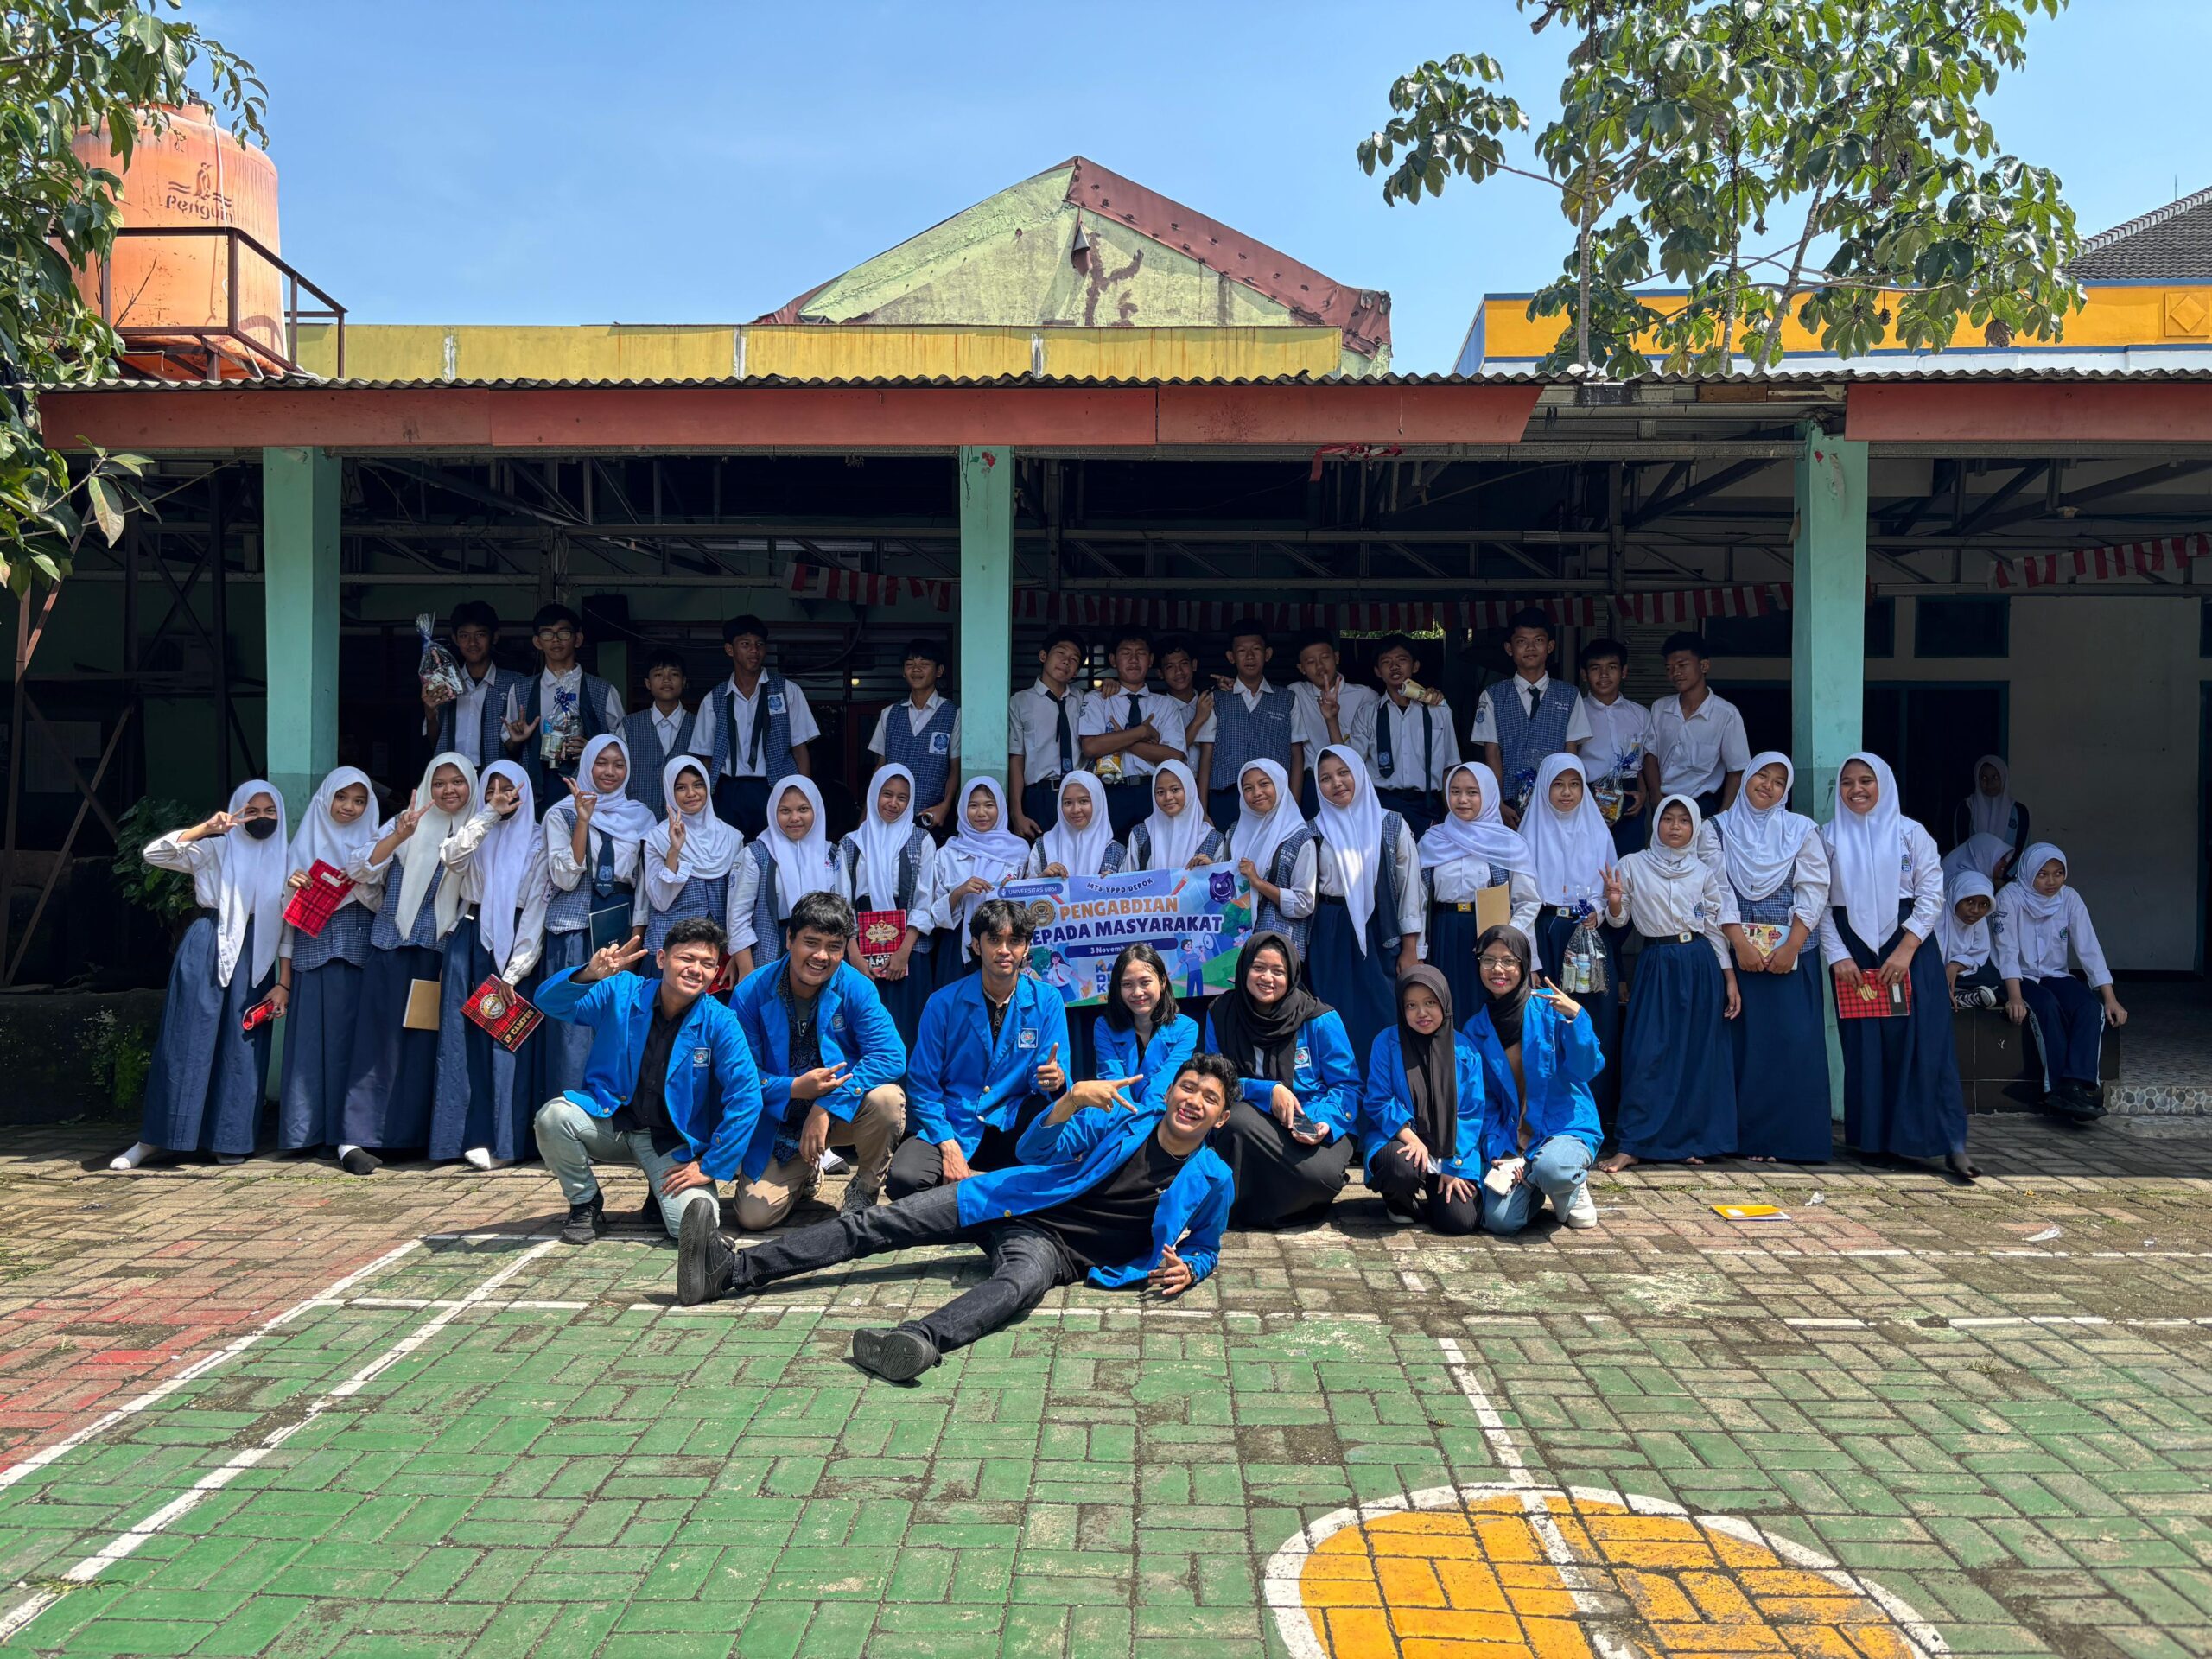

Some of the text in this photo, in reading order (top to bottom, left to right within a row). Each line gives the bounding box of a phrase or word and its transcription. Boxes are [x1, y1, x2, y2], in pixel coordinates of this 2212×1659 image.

[166, 194, 233, 224] Penguin
[1008, 887, 1044, 895] UNIVERSITAS
[1086, 881, 1103, 893] MTS
[1128, 878, 1154, 893] DEPOK
[1060, 898, 1178, 921] PENGABDIAN
[1030, 917, 1222, 946] EPADA MASYARAKAT
[511, 1009, 534, 1035] CAMPUS
